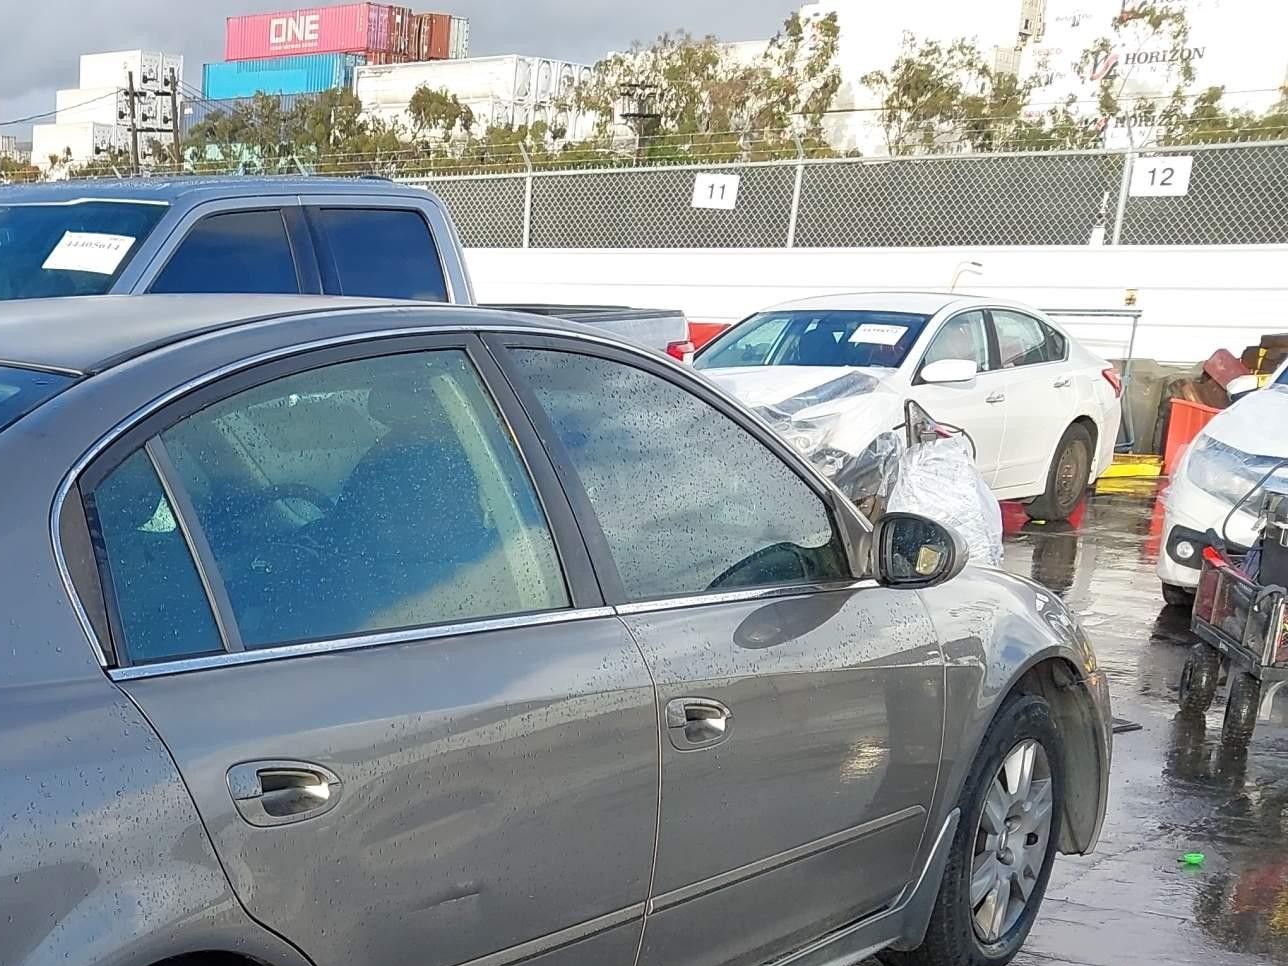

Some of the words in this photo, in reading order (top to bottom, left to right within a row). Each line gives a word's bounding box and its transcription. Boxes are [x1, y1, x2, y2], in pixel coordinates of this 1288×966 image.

[270, 14, 320, 43] ONE
[1124, 46, 1207, 65] HORIZON
[1148, 167, 1175, 187] 12
[707, 183, 726, 200] 11
